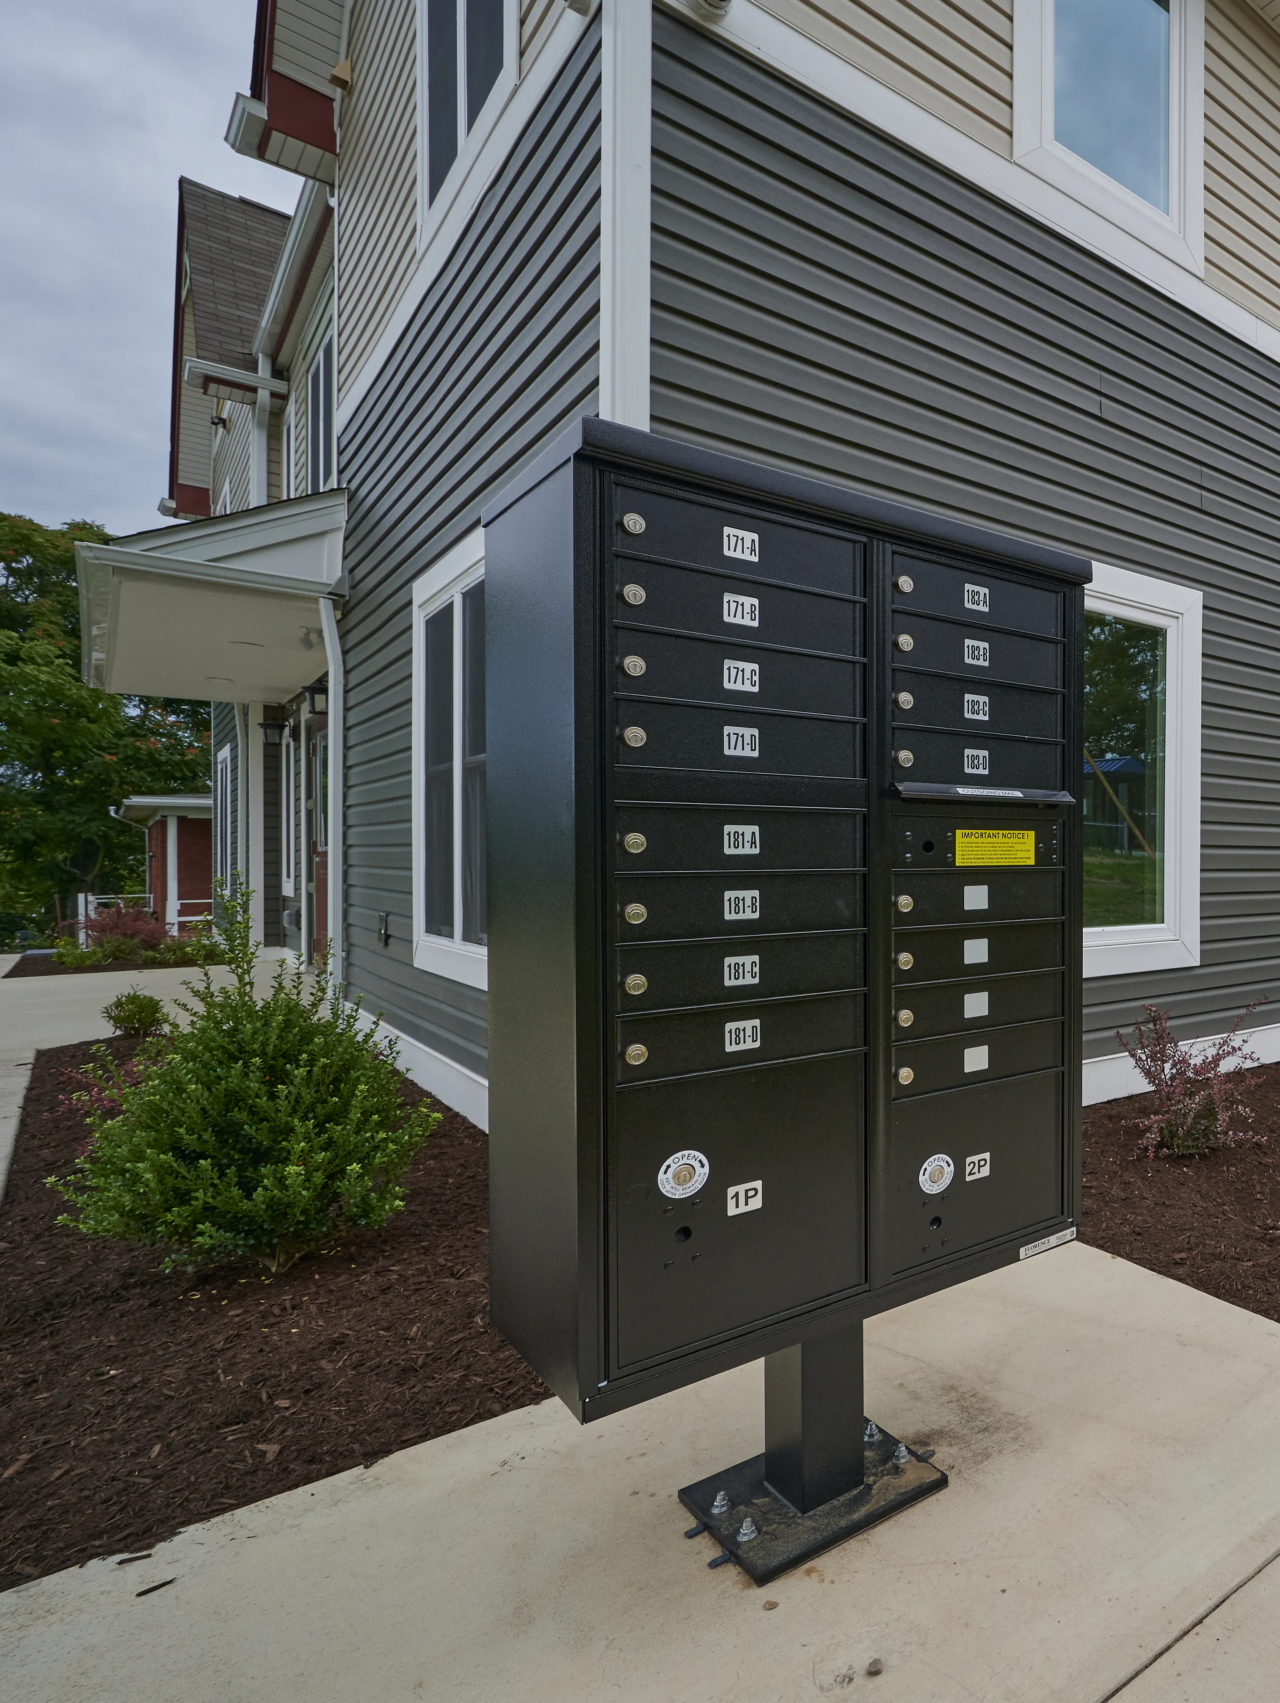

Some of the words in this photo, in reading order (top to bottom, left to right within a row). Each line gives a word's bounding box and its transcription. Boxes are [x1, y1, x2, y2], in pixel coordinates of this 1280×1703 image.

[726, 533, 757, 557] 171-A
[966, 589, 988, 608] 183-A
[726, 599, 757, 621] 171-B
[966, 644, 988, 662] 183-B
[726, 666, 757, 687] 171-C
[966, 699, 987, 716] 183-C
[726, 732, 757, 752] 171-D
[966, 754, 987, 770] 183-D
[726, 831, 757, 849] 181-A
[727, 896, 758, 915] 181-B
[727, 961, 757, 981] 181-C
[727, 1025, 758, 1046] 181-D
[672, 1153, 699, 1164] OPEN
[927, 1157, 946, 1167] OPEN
[967, 1158, 988, 1177] 2P
[665, 1189, 678, 1197] AFTER
[678, 1185, 699, 1197] OPENING
[681, 1179, 699, 1192] REMAIN
[731, 1187, 759, 1209] 1P
[1024, 1239, 1051, 1252] FLORENCE
